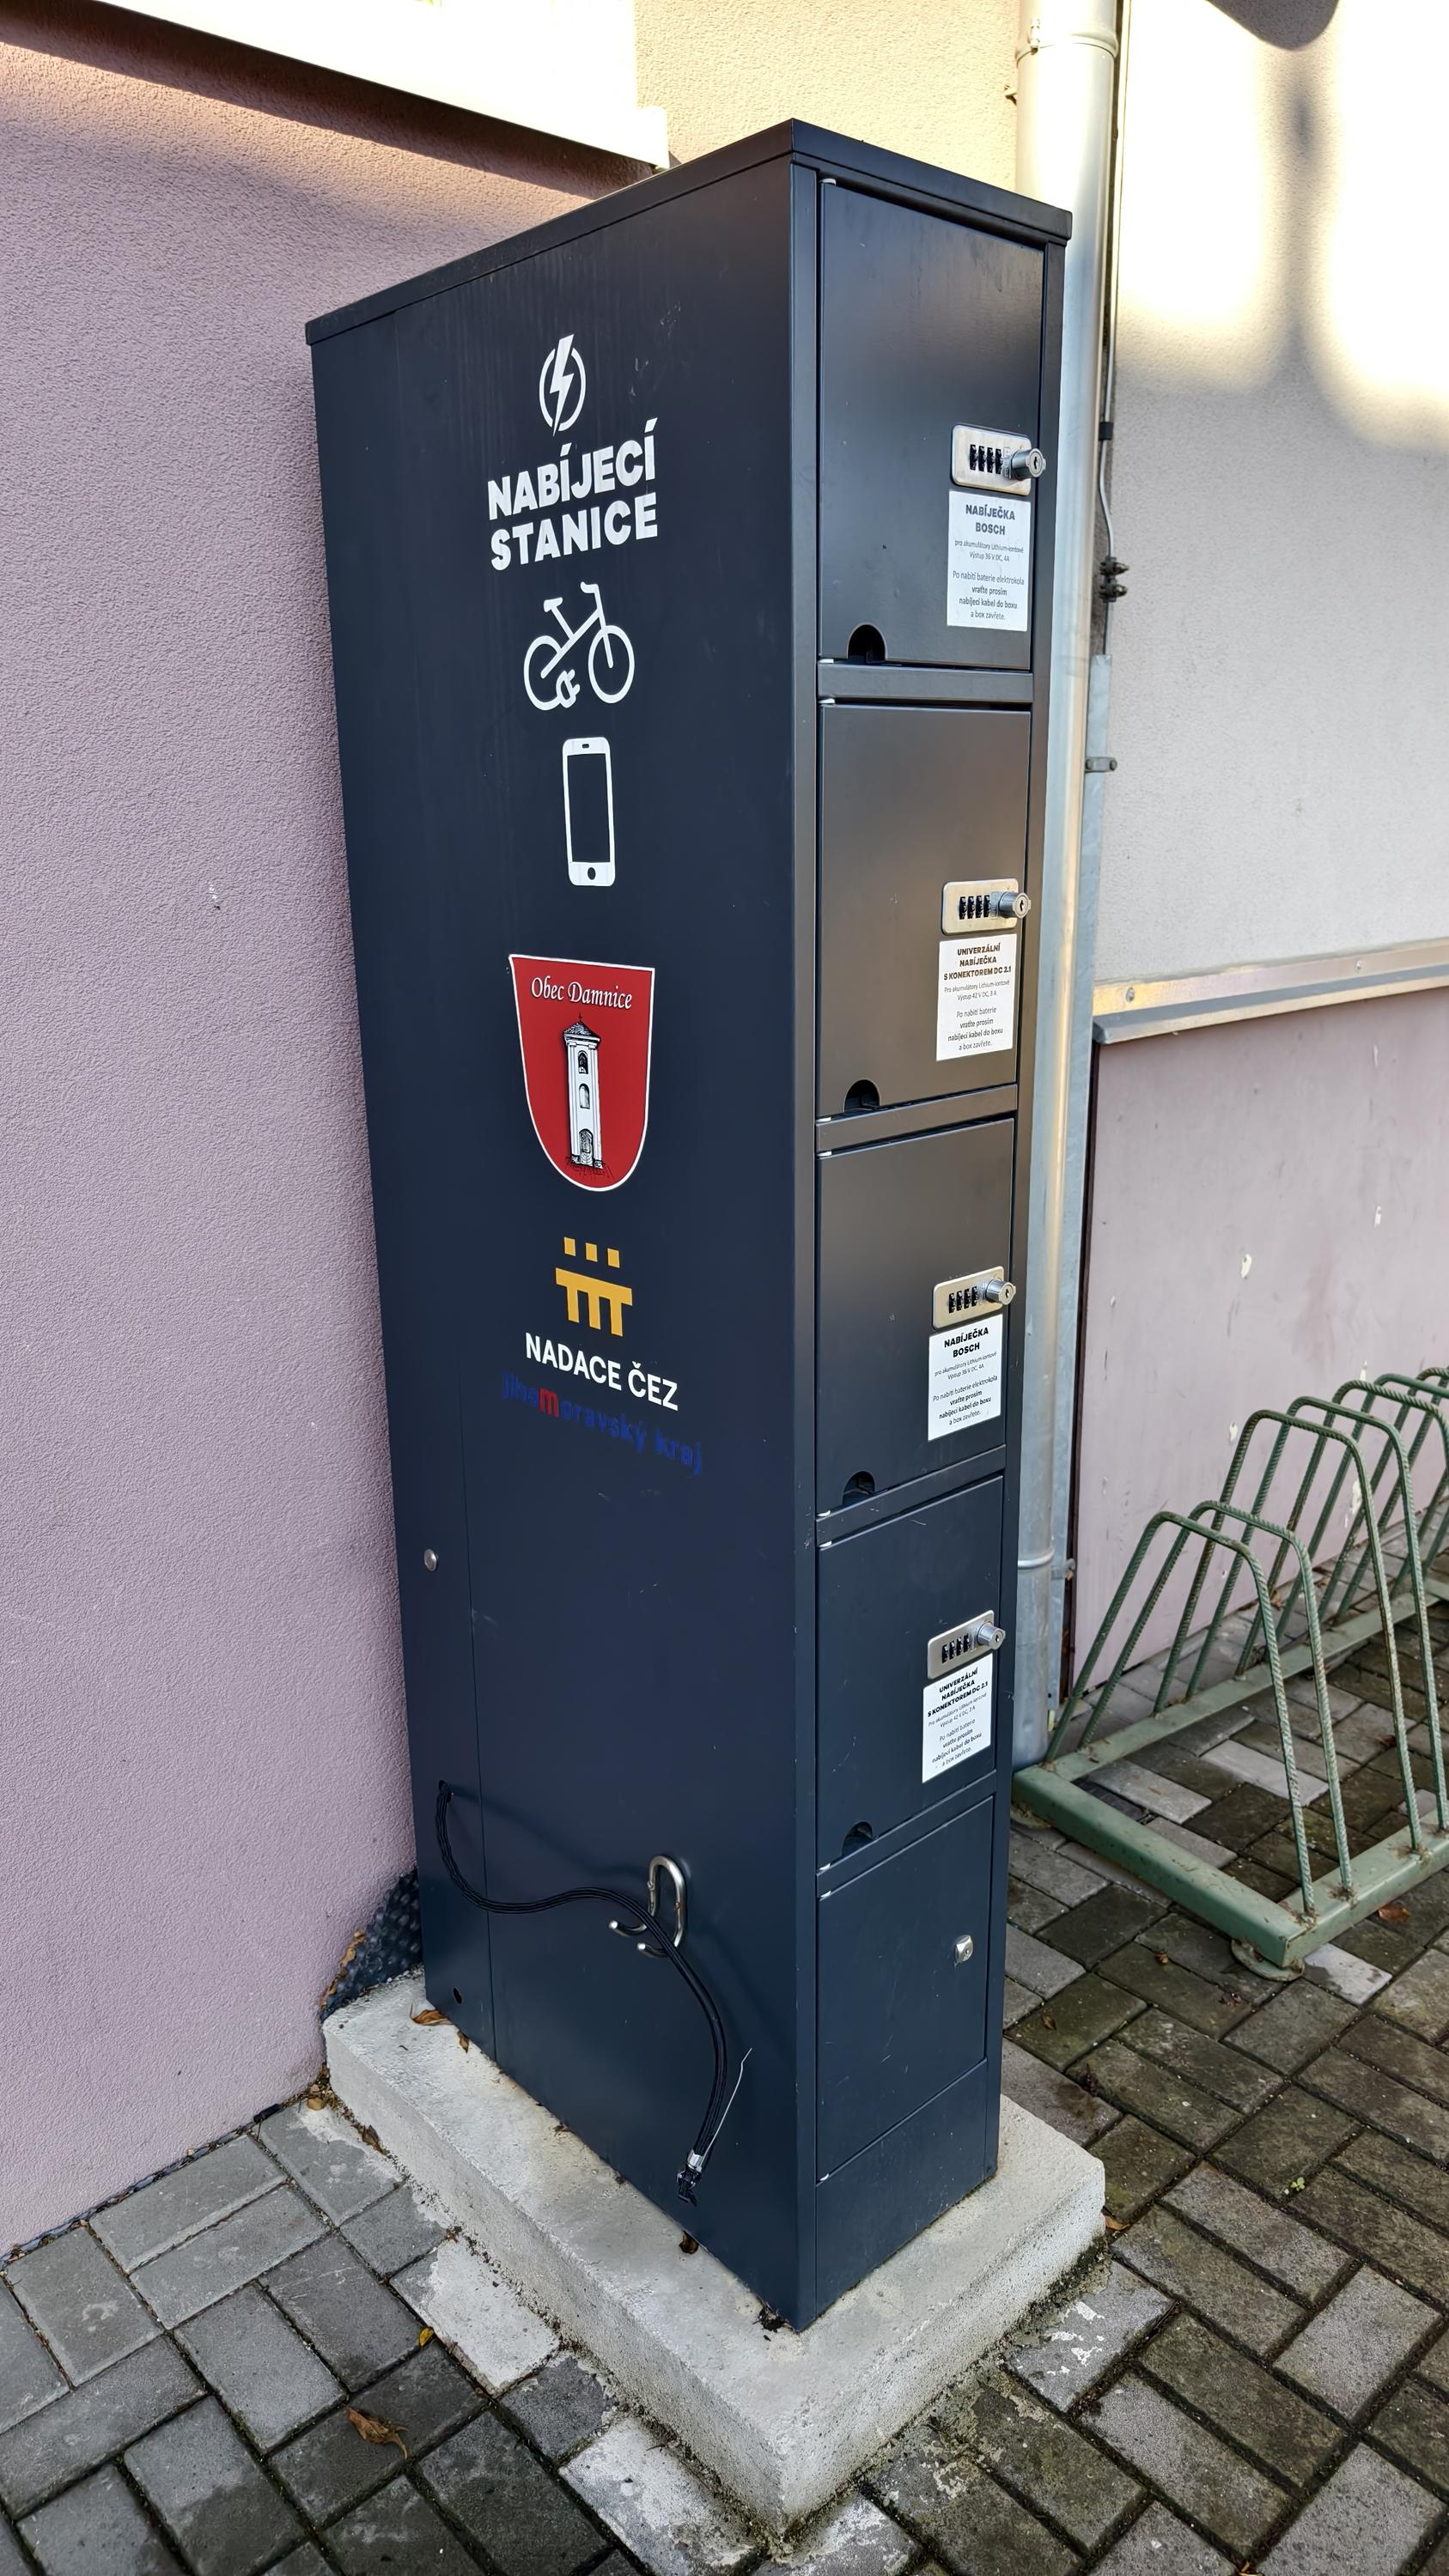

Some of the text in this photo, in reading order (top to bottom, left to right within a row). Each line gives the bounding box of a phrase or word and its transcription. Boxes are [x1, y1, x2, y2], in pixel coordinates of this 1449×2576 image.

[487, 417, 658, 520] NABÍJECÍ
[965, 504, 1015, 520] NABÍJEČKA
[490, 492, 658, 570] STANICE
[976, 522, 1006, 536] BOSCH
[969, 551, 984, 560] Výstup
[953, 570, 1025, 586] Po nabití baterie elektrokola
[971, 586, 988, 594] vraťte
[981, 598, 995, 607] kabel
[1004, 600, 1017, 609] boxu
[957, 942, 1001, 956] UNIVERZÁLNÍ
[959, 955, 997, 967] NABÍJEČKA
[949, 968, 993, 980] KONEKTOREM
[531, 975, 632, 1009] Obec Damnice
[964, 1008, 978, 1017] nabití
[979, 1006, 996, 1015] baterie
[959, 1018, 994, 1029] vraťte prosím
[969, 1030, 983, 1038] kabel
[944, 1327, 989, 1348] NABÍJEČKA
[953, 1342, 980, 1358] BOSCH
[526, 1332, 679, 1411] NADACE ČEZ
[954, 1384, 971, 1394] baterie
[965, 1390, 983, 1401] prosím
[959, 1402, 971, 1413] kabel
[655, 1427, 701, 1475] kraj
[939, 1668, 977, 1693] UNIVERZÁLNÍ
[941, 1680, 975, 1701] NABÍJEČKA
[932, 1690, 971, 1715] KONEKTOREM
[972, 1685, 980, 1694] DC
[959, 1719, 976, 1731] baterie
[951, 1741, 964, 1753] kabel
